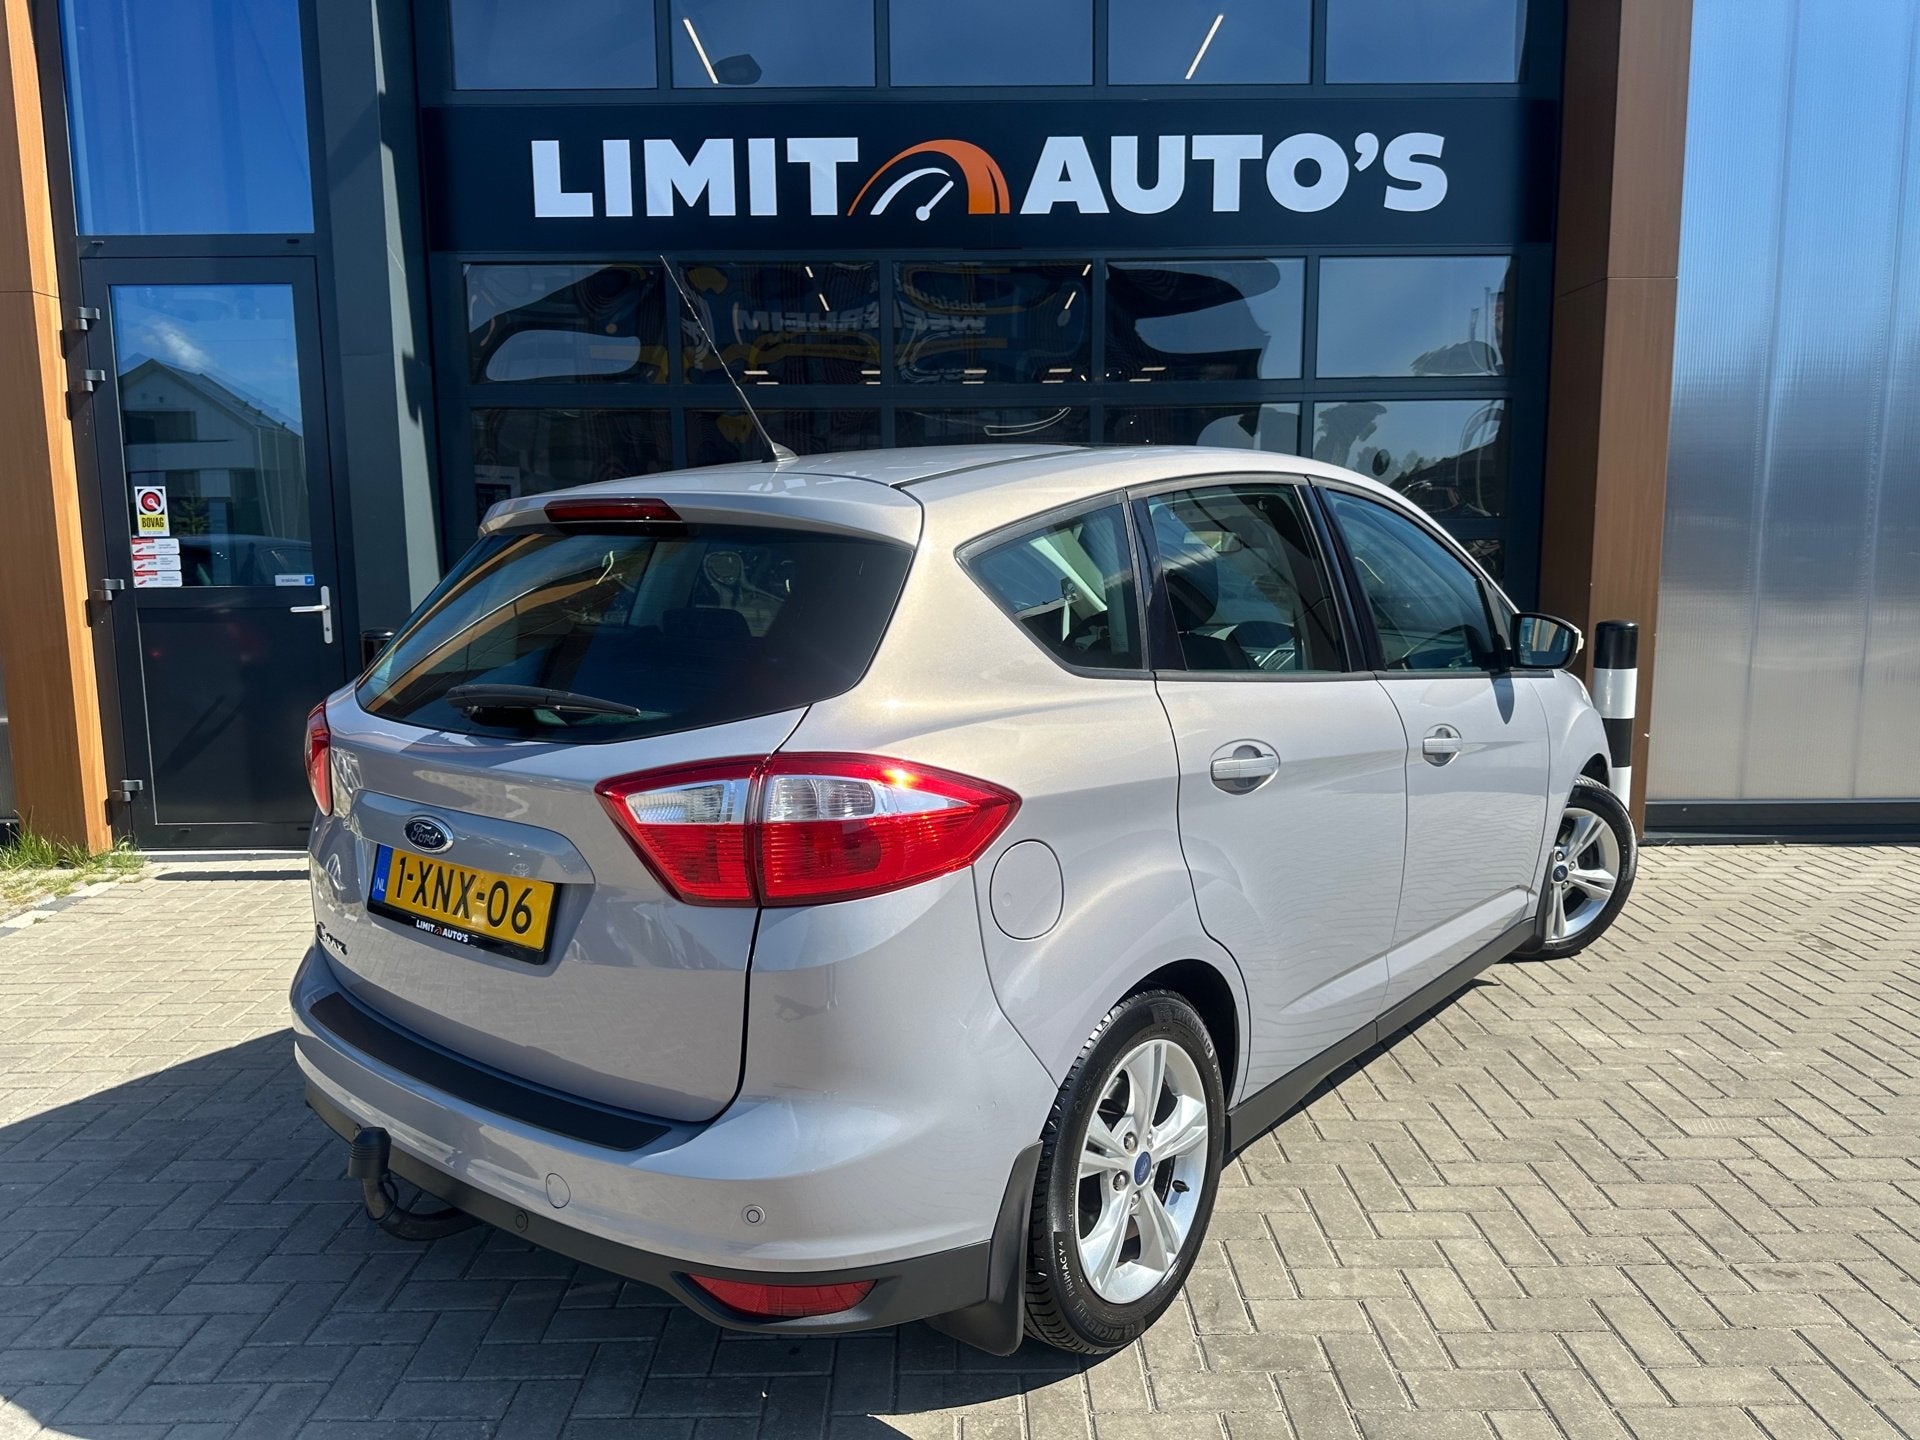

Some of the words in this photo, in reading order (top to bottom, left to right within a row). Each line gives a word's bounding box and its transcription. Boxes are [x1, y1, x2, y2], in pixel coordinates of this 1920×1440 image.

[531, 137, 858, 218] LIMIT
[1020, 132, 1448, 215] AUTO'S
[141, 517, 164, 528] BOVAG
[410, 822, 437, 846] Ford
[375, 878, 385, 892] NL
[396, 856, 533, 935] 1-XNX-06
[416, 919, 436, 933] LIMIT
[442, 929, 469, 944] AUTO'S
[1057, 1247, 1076, 1298] PRIMACY
